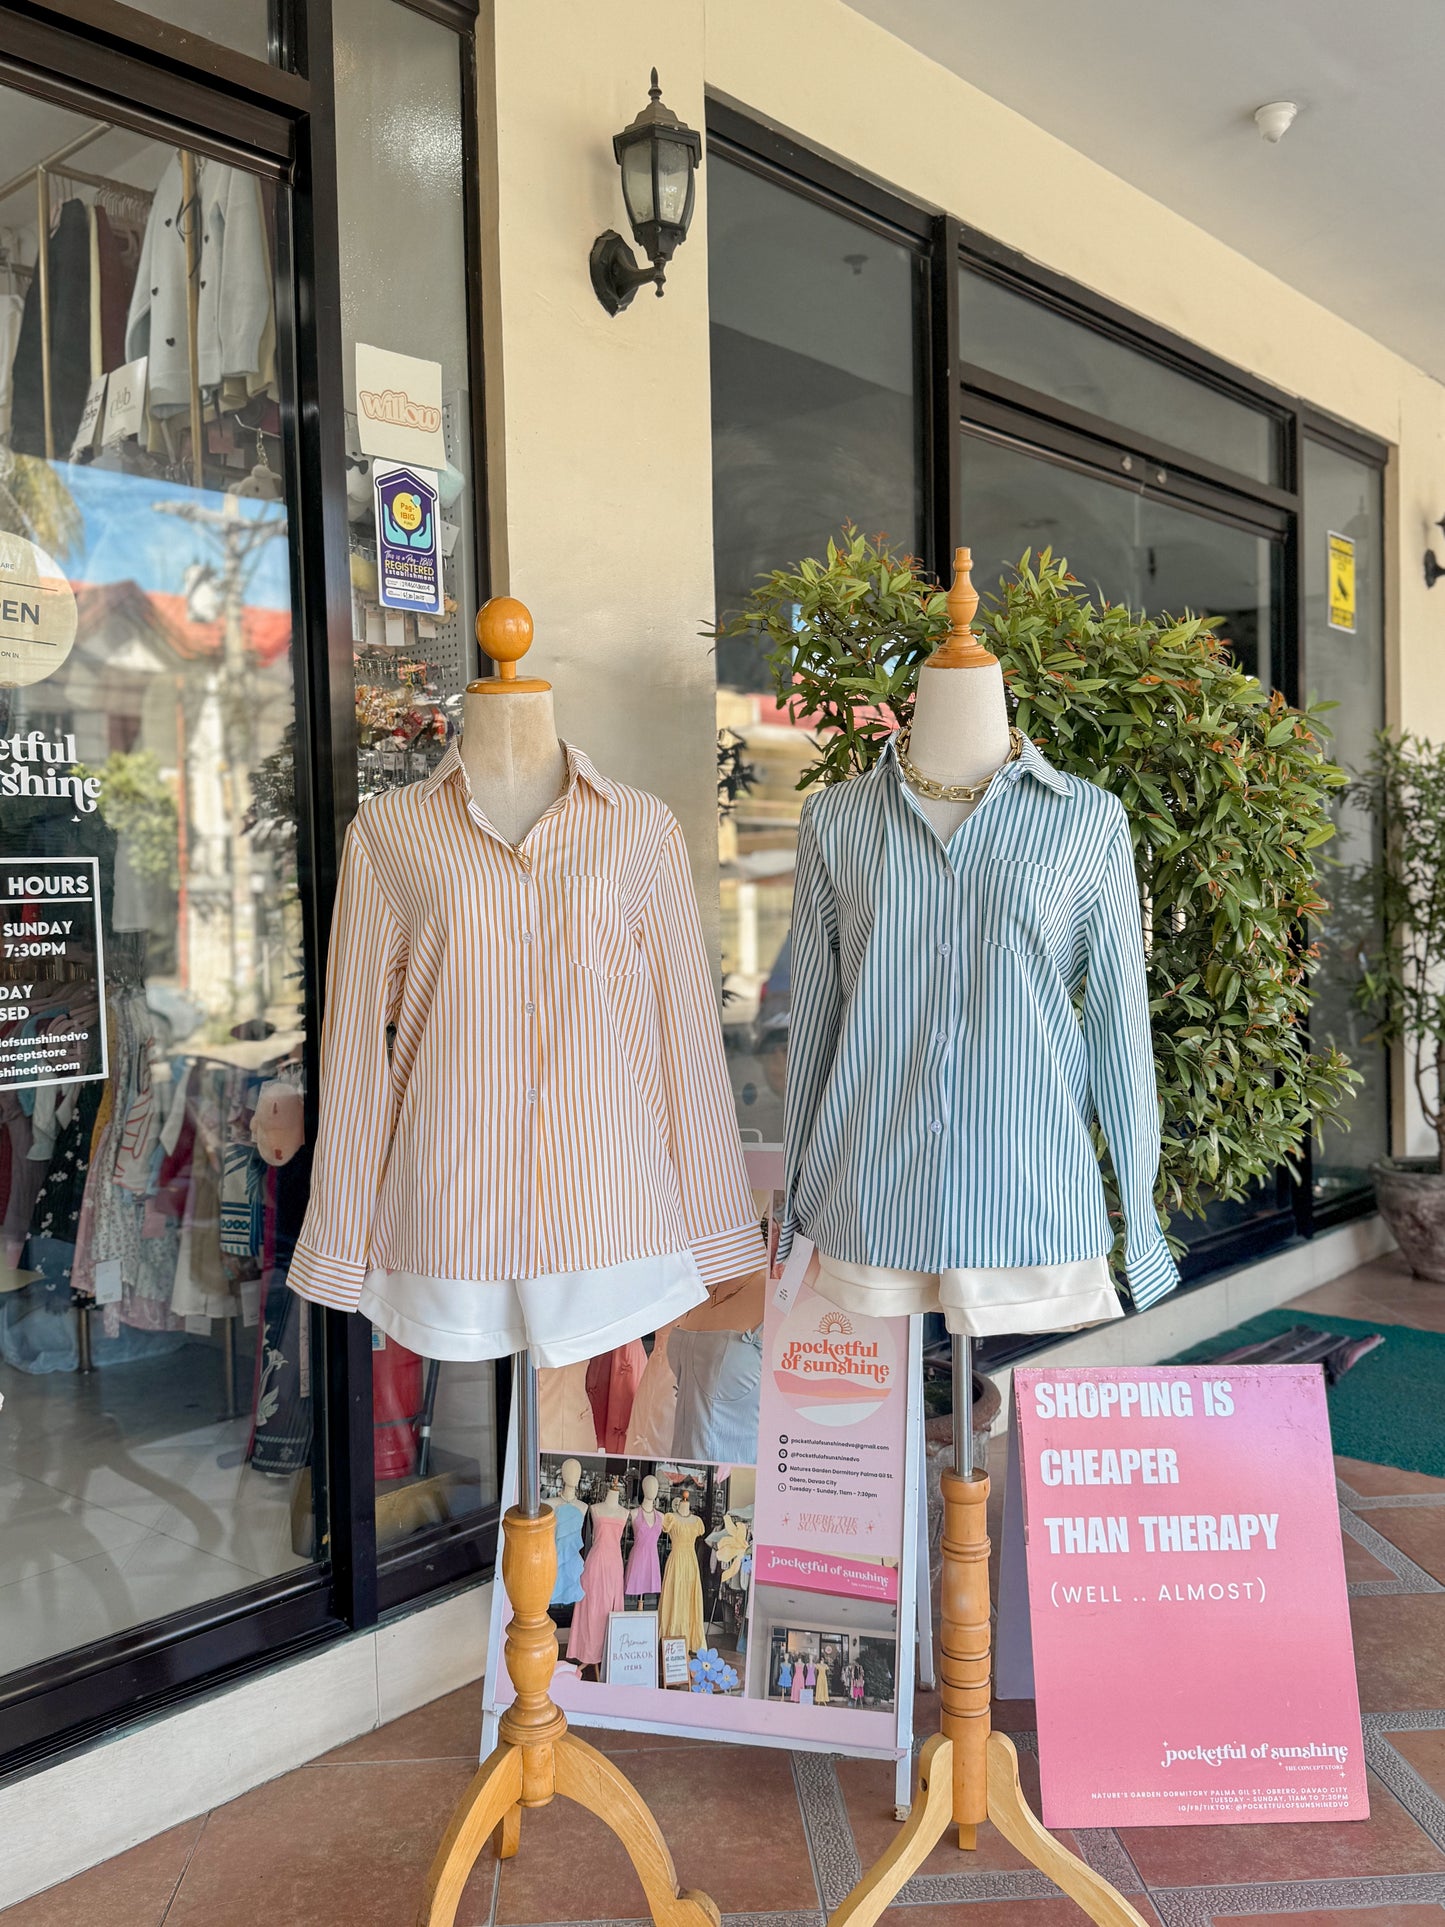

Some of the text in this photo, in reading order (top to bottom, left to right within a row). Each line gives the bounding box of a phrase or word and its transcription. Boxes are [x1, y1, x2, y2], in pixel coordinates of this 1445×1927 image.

[400, 502, 415, 513] Pag-
[400, 512, 416, 521] IBIG
[384, 559, 435, 576] REGISTERED
[385, 568, 435, 582] Establishment
[0, 599, 40, 625] EN
[0, 762, 102, 813] shine
[8, 875, 89, 896] HOURS
[3, 920, 73, 937] SUNDAY
[4, 941, 67, 958] 7:30PM
[0, 984, 33, 1000] DAY
[0, 1006, 30, 1021] SED
[783, 1339, 878, 1362] pocketful
[781, 1354, 890, 1384] of sunshine
[1034, 1380, 1235, 1419] SHOPPING IS
[832, 1469, 860, 1477] Dormitory
[1040, 1448, 1179, 1486] CHEAPER
[789, 1485, 812, 1494] Tuesday
[817, 1487, 839, 1495] Sunday,
[857, 1491, 878, 1499] 7:30pm
[798, 1521, 858, 1535] SUN SHINES
[799, 1512, 858, 1528] WHERE THE
[1043, 1513, 1279, 1554] THAN THERAPY
[768, 1555, 828, 1575] pocketful
[830, 1565, 842, 1576] of
[843, 1570, 889, 1588] sunshine
[1051, 1581, 1122, 1608] (WELL
[1158, 1577, 1266, 1603] ALMOST)
[612, 1650, 653, 1661] BANGKOK
[1161, 1742, 1348, 1767] pocketful of sunshine
[1235, 1801, 1349, 1812] @POCKETFULOFSUNSHINEDVO
